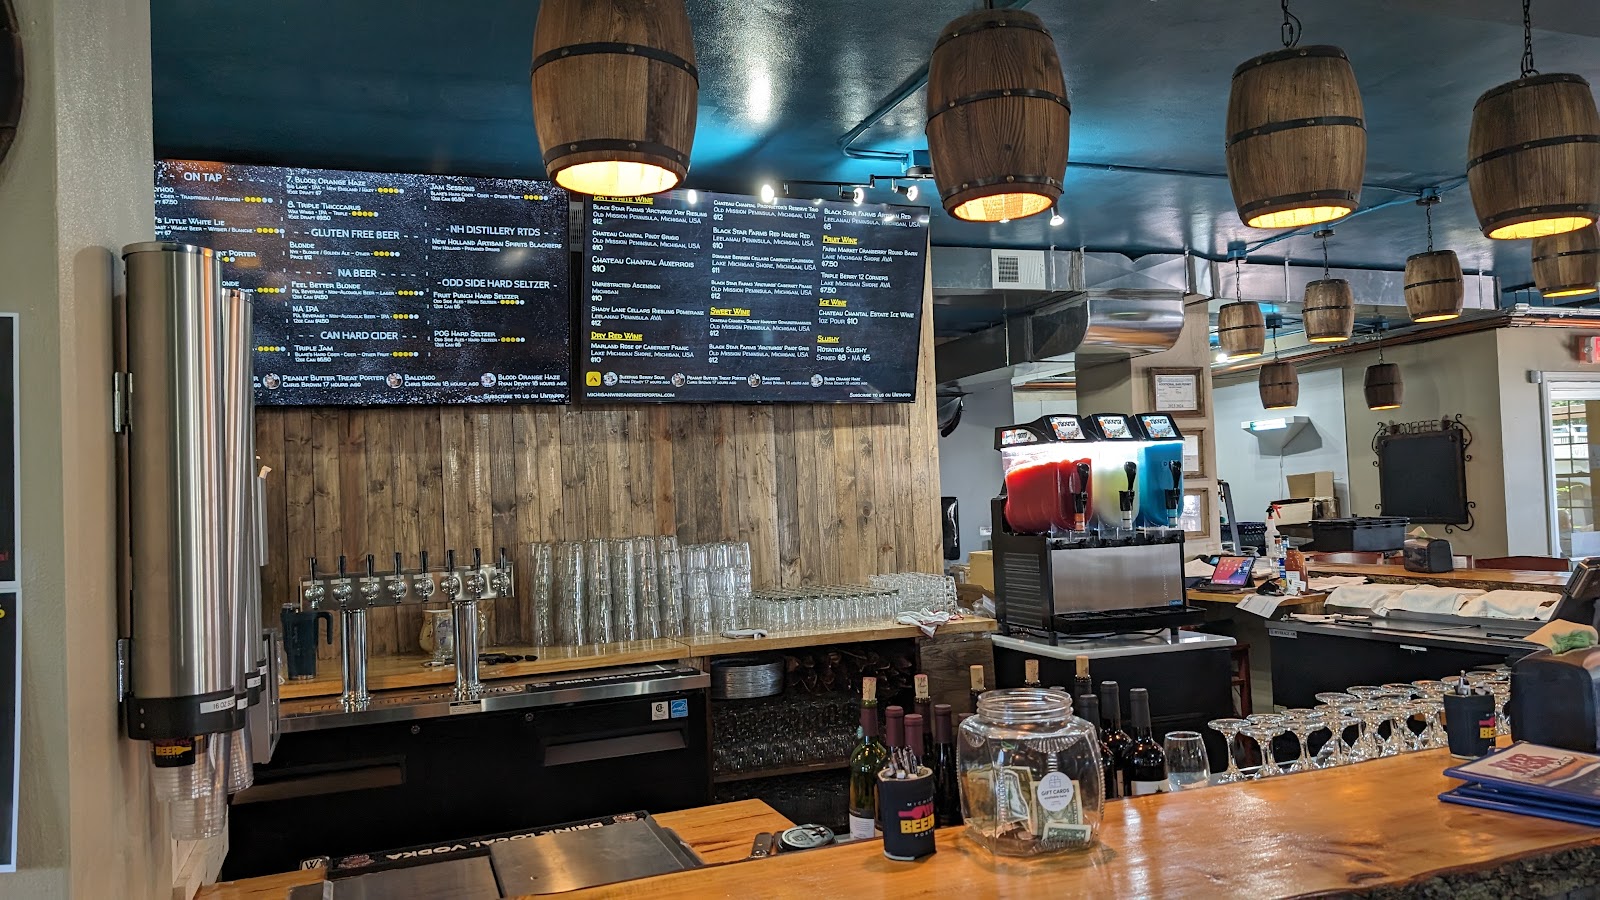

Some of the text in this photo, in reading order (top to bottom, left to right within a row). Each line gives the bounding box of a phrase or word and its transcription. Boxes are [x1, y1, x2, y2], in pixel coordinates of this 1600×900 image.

[203, 174, 222, 182] TAP
[311, 229, 400, 239] GLUTEN FREE BEER
[467, 226, 515, 235] DISTILLERY
[518, 228, 540, 236] RTDS
[823, 235, 857, 244] FRUIT WINE
[592, 256, 694, 268] CHATEAU CHANTAL AUXERROIS
[338, 269, 351, 277] NA
[710, 307, 732, 315] SWEET
[386, 822, 603, 860] DRINK LOCAL VODKA
